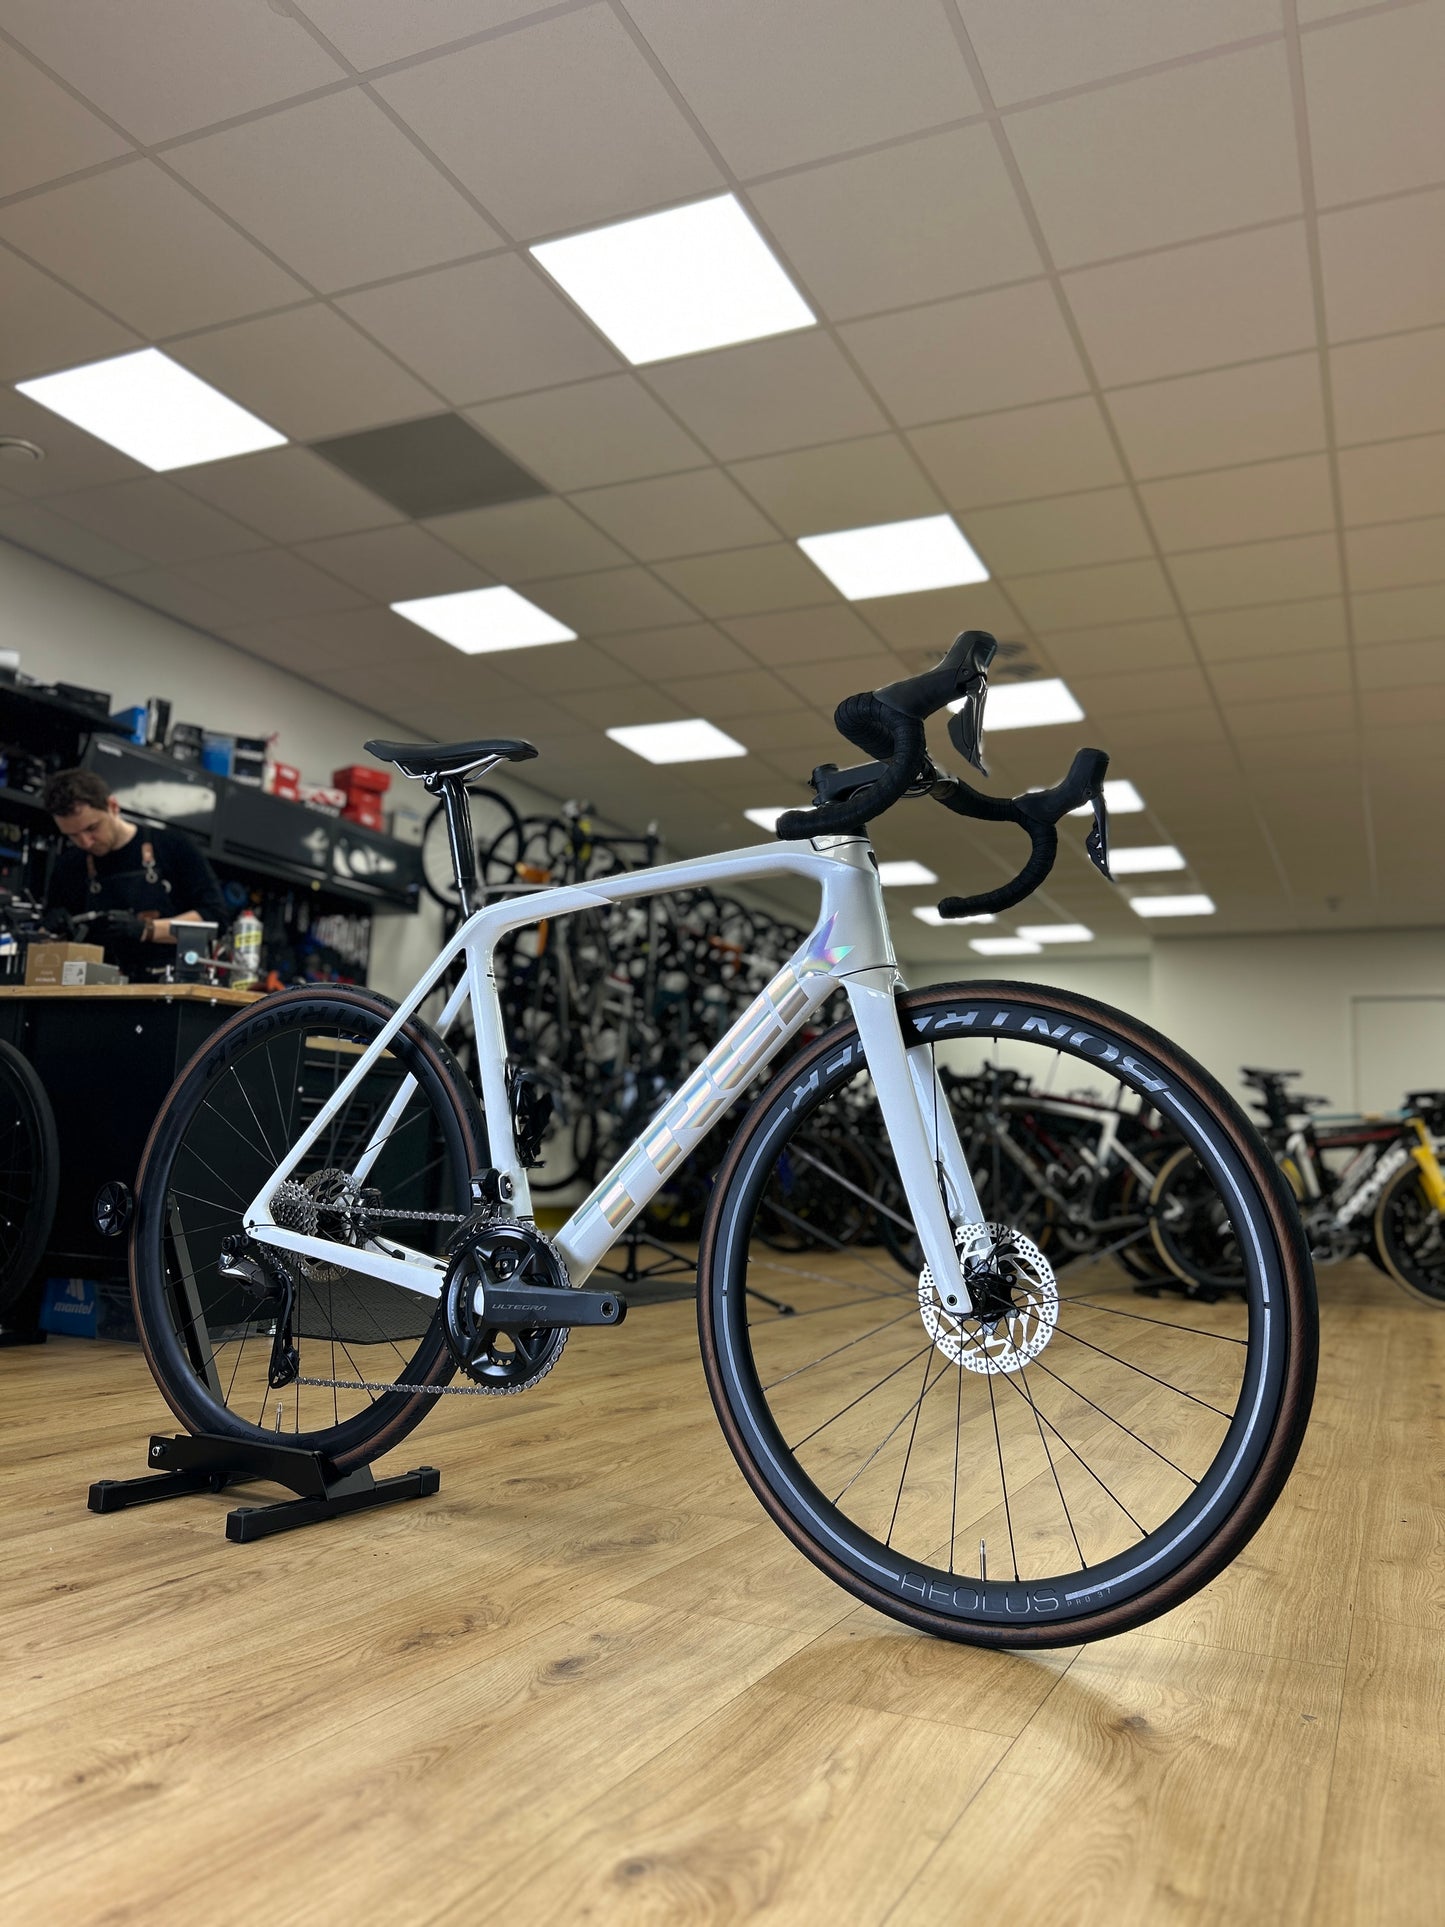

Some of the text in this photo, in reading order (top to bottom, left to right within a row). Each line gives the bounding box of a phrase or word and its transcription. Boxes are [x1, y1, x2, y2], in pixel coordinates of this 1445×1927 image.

[54, 1301, 94, 1315] mantel
[491, 1303, 548, 1312] ULTEGRA
[901, 1571, 1059, 1614] AEOLUS
[1066, 1595, 1091, 1607] PRO
